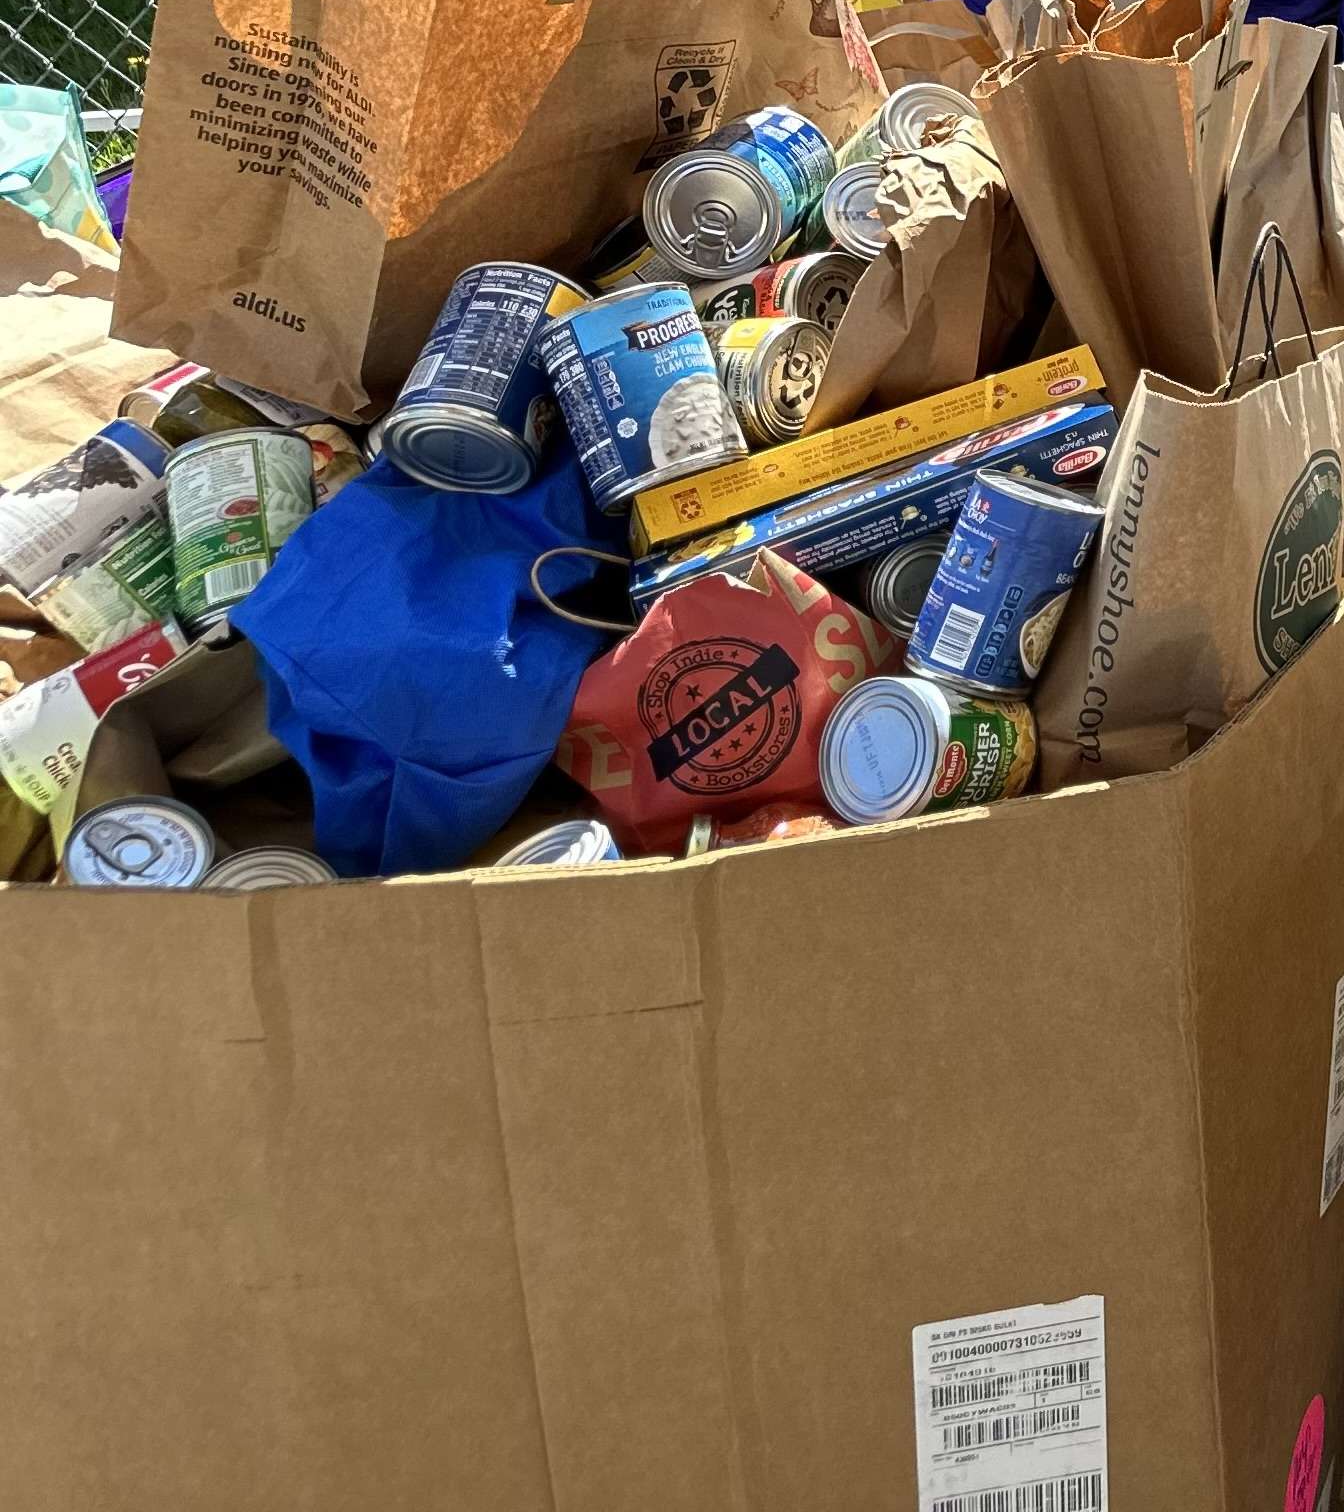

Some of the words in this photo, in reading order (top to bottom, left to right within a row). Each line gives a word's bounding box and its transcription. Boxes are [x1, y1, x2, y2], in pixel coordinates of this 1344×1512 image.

[213, 35, 294, 68] nothing
[297, 56, 324, 81] new
[326, 73, 344, 95] for
[345, 88, 377, 119] ALDI.
[247, 22, 348, 81] Sustainability
[349, 69, 360, 88] is
[666, 56, 698, 66] Clean
[708, 55, 727, 66] Dry
[674, 47, 717, 59] Recycle
[200, 71, 259, 97] doors
[261, 83, 282, 103] in
[286, 91, 325, 119] 1976,
[328, 111, 346, 131] we
[348, 123, 378, 155] have
[227, 56, 281, 81] Since
[284, 72, 342, 115] opening
[344, 107, 366, 128] our
[189, 108, 300, 146] minimizing
[302, 134, 337, 168] waste
[337, 159, 373, 194] while
[215, 93, 266, 119] been
[271, 110, 349, 155] committed
[349, 146, 363, 165] to
[197, 125, 273, 160] helping
[277, 145, 307, 167] you
[307, 160, 364, 209] maximize
[237, 157, 286, 177] your
[289, 166, 331, 211] savings.
[230, 287, 310, 337] aldi.us
[1039, 438, 1083, 461] SPAGHETTI
[1053, 449, 1103, 474] Barilla
[1083, 429, 1110, 444] THIN
[885, 470, 935, 493] THIN
[1079, 440, 1161, 765] lennyshoe.com
[647, 665, 674, 709] Shop
[670, 646, 726, 673] Indie
[670, 676, 774, 758] LOCAL
[704, 714, 790, 788] Bookstores
[972, 733, 1001, 802] CRISP
[938, 777, 954, 794] Del
